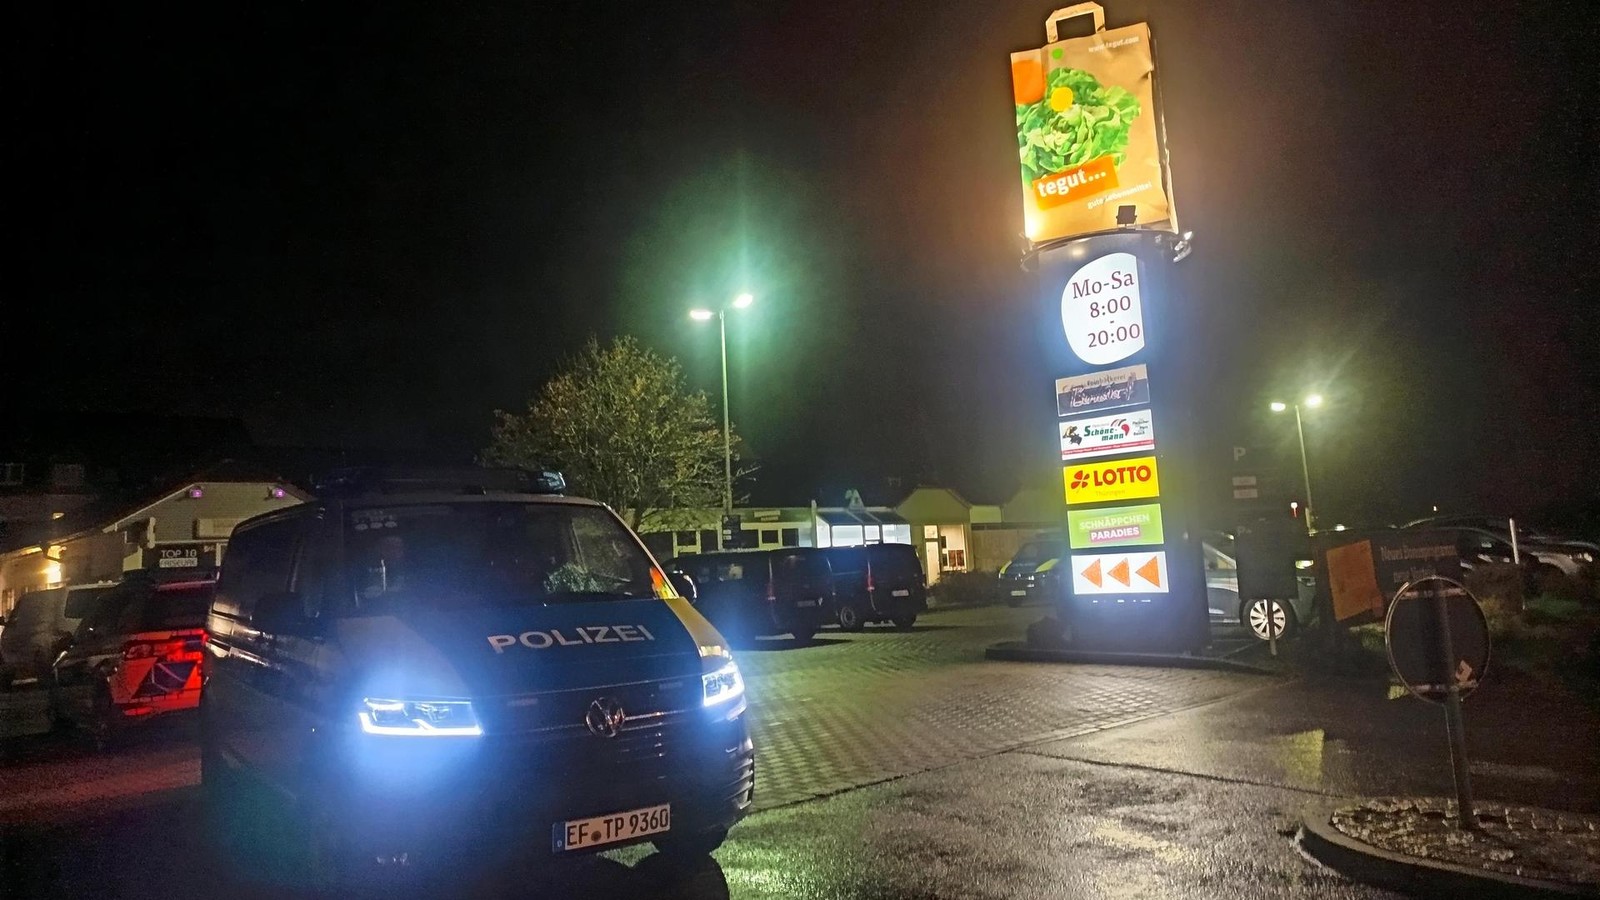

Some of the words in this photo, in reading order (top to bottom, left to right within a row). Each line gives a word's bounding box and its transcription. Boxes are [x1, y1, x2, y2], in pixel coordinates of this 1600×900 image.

[1072, 270, 1135, 299] Mo-Sa
[1089, 295, 1131, 318] 8:00
[1088, 323, 1141, 348] 20:00
[1101, 433, 1124, 441] mann
[1094, 465, 1152, 486] LOTTO
[1080, 514, 1149, 530] SCHNÄPPCHEN
[1090, 528, 1139, 541] PARADIES
[160, 549, 182, 558] TOP
[487, 624, 655, 655] POLIZEI
[567, 822, 590, 847] EF
[603, 817, 625, 840] TP
[629, 808, 669, 835] 9360
